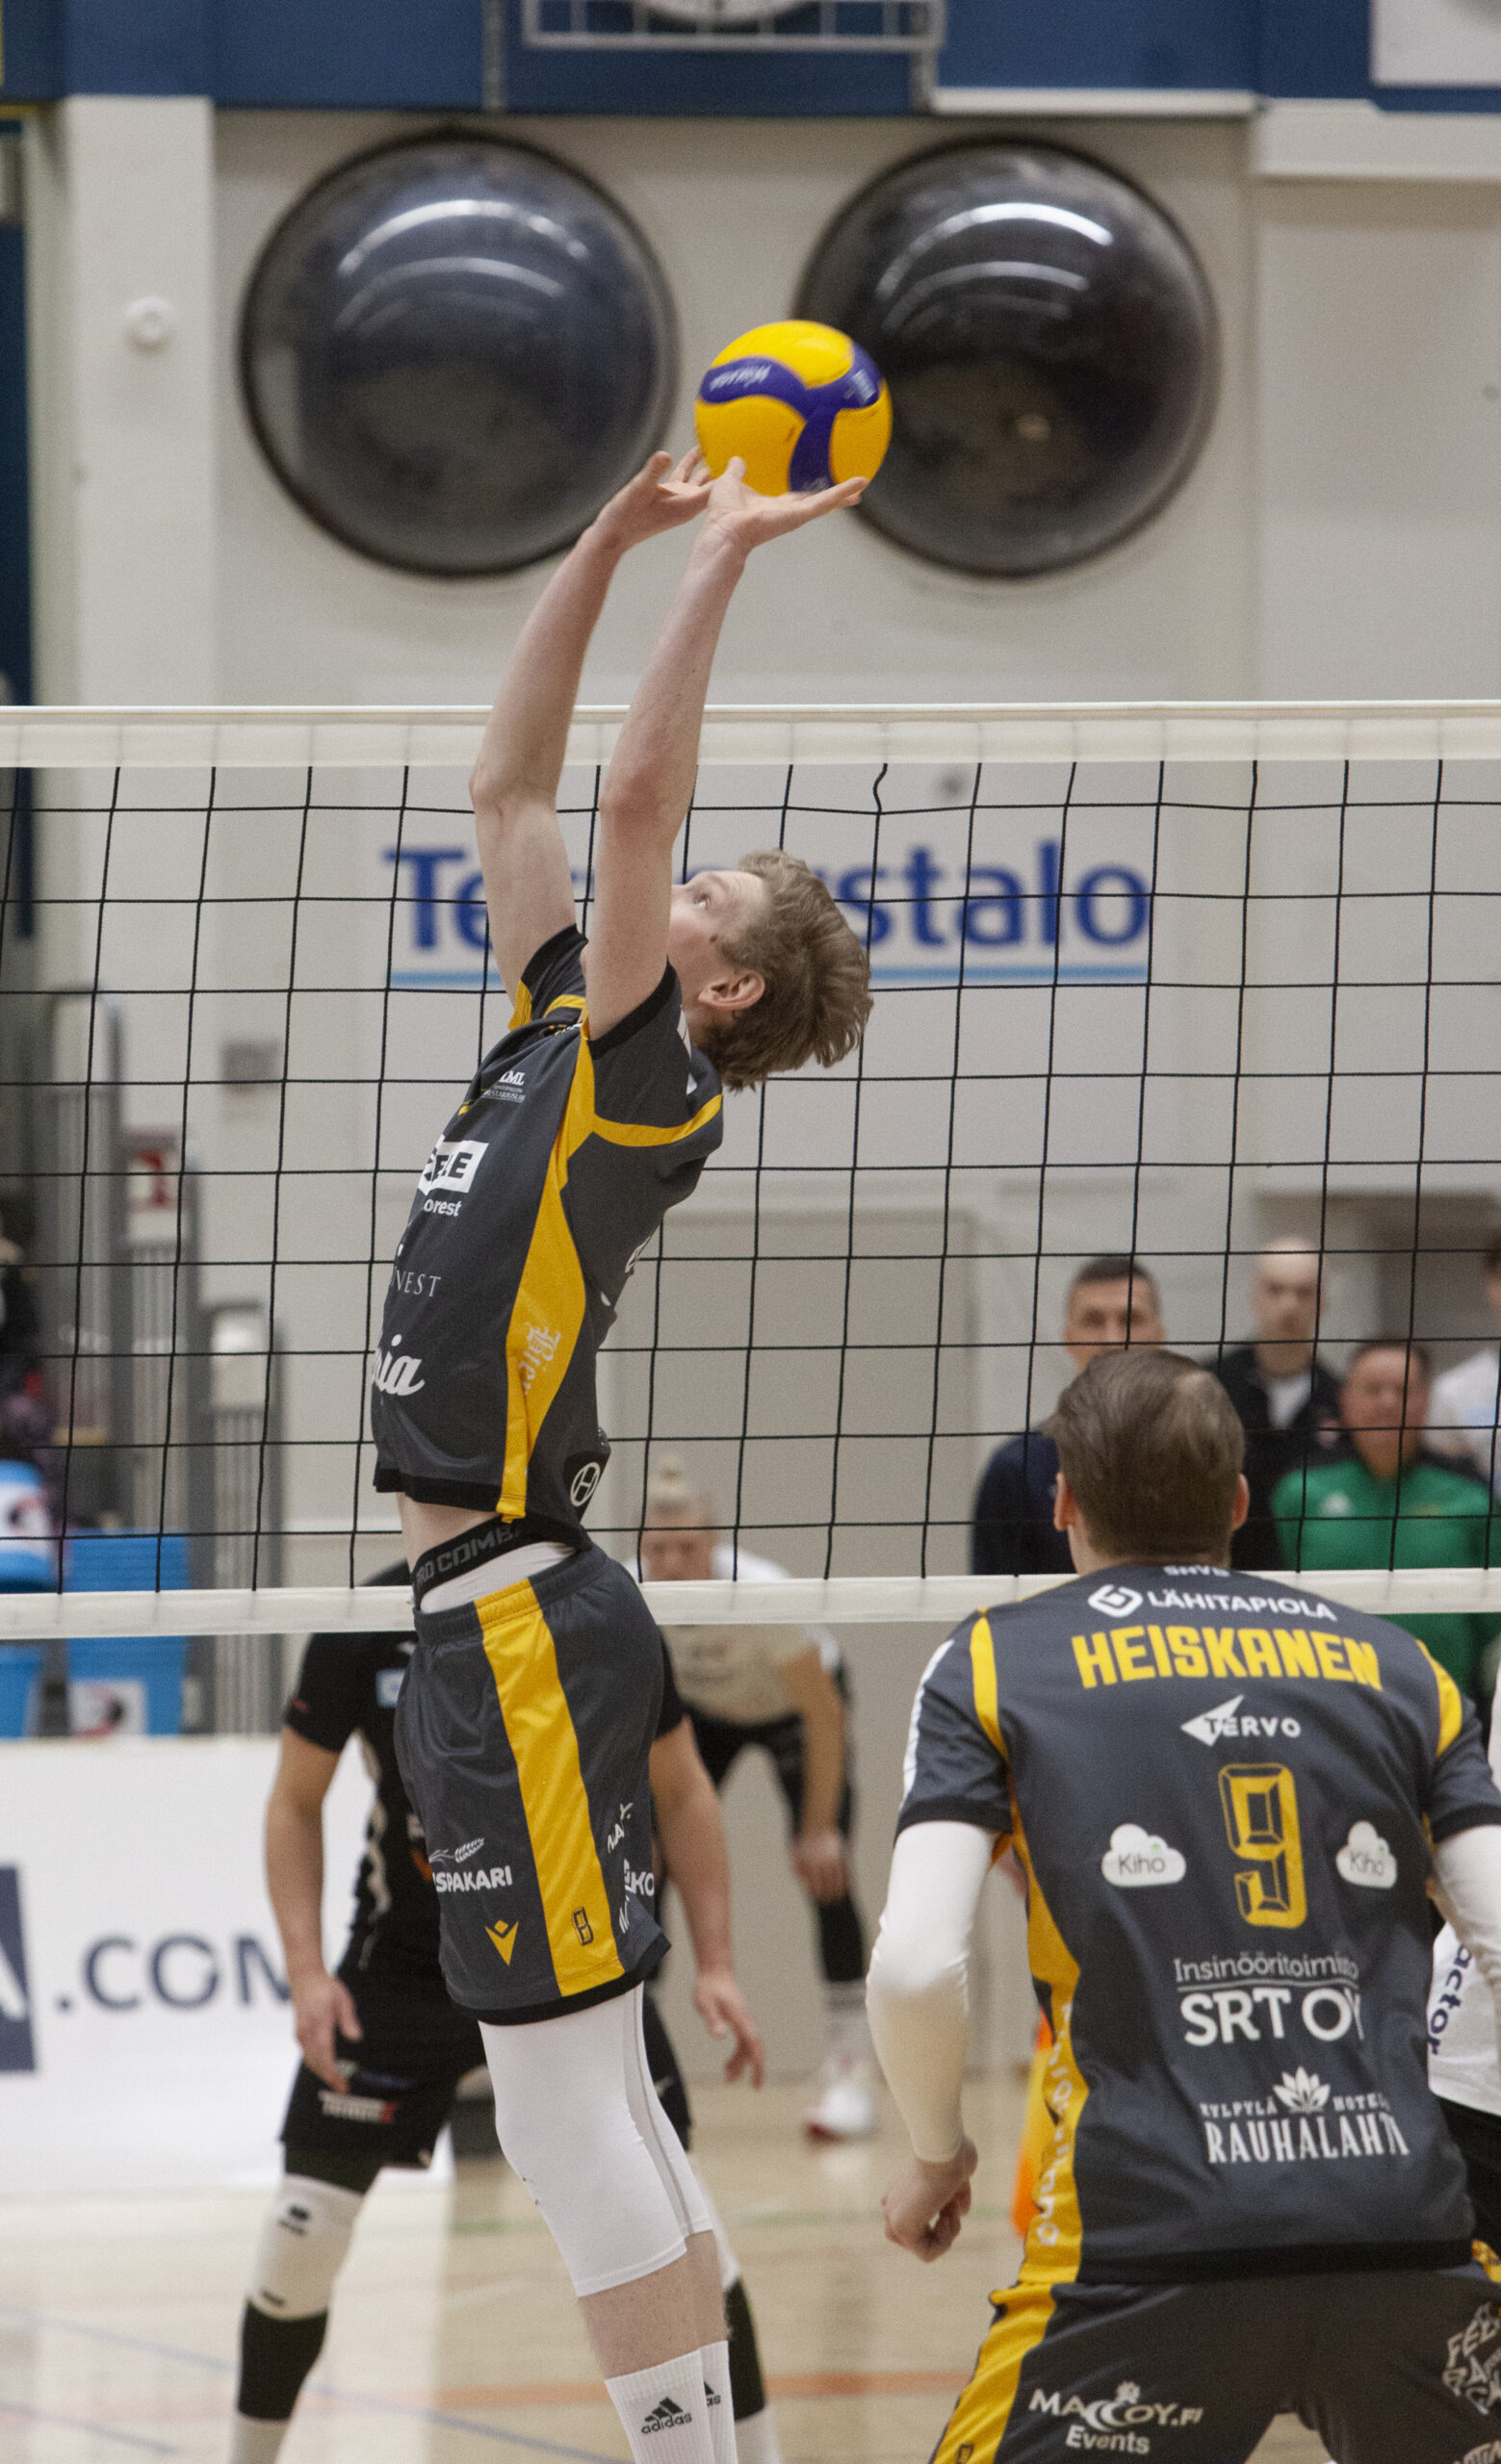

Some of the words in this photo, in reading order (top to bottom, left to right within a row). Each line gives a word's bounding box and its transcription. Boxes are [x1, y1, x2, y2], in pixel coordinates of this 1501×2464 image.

[383, 837, 1148, 953] Testalo
[424, 1198, 462, 1217] orest
[1148, 1589, 1337, 1622] LÄHITAPIOLA
[1071, 1625, 1383, 1691] HEISKANEN
[1203, 1716, 1302, 1738] TERVO
[1217, 1762, 1308, 1928] 9
[432, 1865, 512, 1893] SPAKARI
[1118, 1853, 1167, 1876] Kiho
[1180, 1988, 1292, 2047] SRT
[640, 2412, 693, 2435] adidas
[1065, 2424, 1152, 2455] Events
